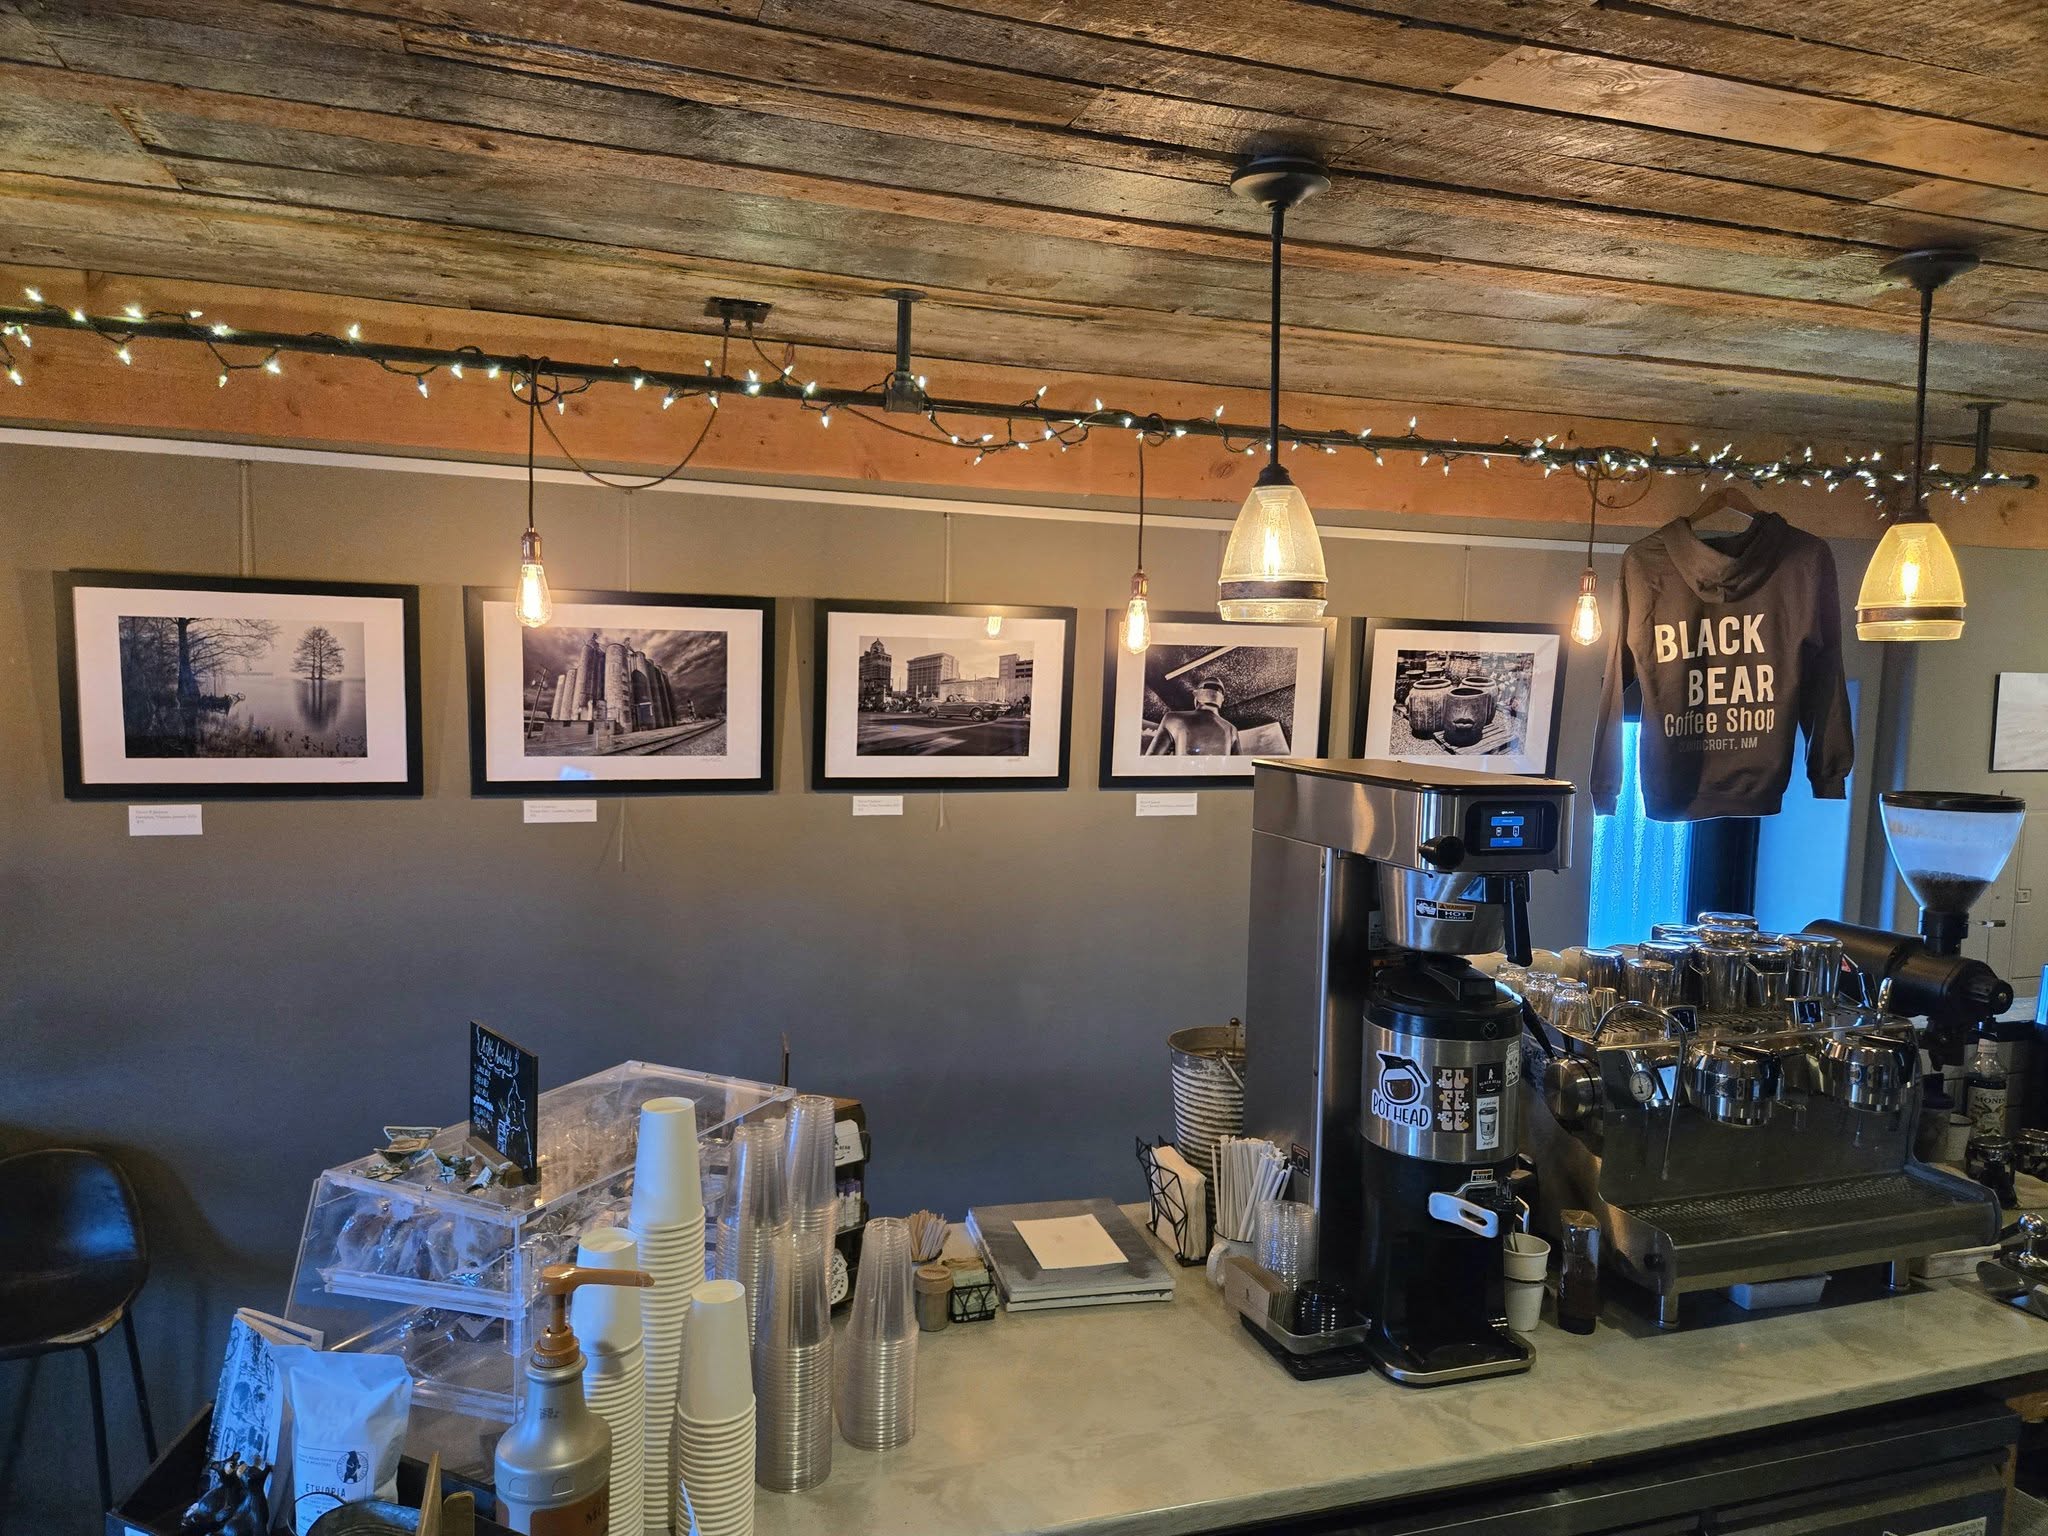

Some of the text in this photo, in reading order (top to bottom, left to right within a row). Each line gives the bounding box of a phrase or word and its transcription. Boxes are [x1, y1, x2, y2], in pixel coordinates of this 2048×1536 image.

[1654, 613, 1765, 663] BLACK
[1688, 664, 1774, 707] BEAR
[1664, 706, 1775, 738] Coffee Shop
[1680, 737, 1758, 752] CROFT, NM
[1373, 1092, 1429, 1128] POT HEAD
[305, 1483, 346, 1498] ETHIOPIA
